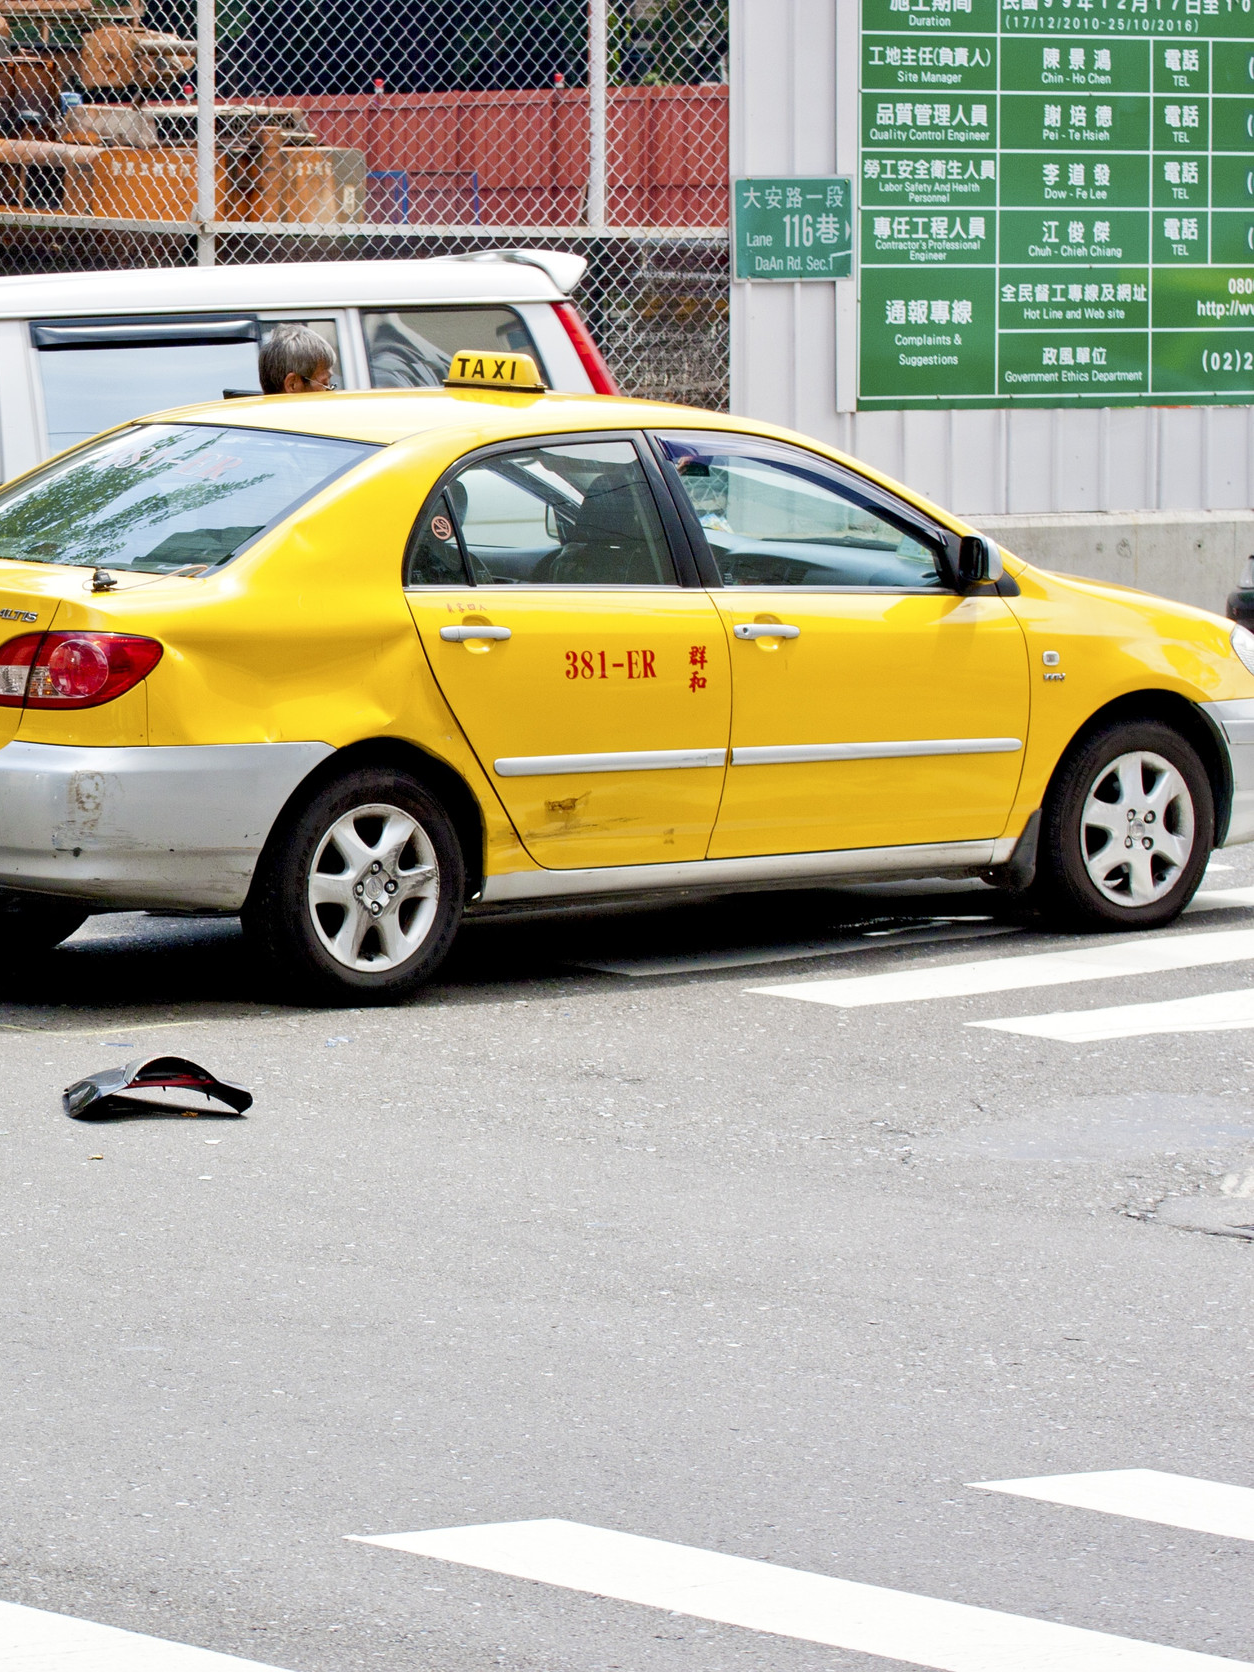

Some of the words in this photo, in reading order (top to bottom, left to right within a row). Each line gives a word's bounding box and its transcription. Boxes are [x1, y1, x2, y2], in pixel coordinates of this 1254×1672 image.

[908, 14, 951, 27] Duration
[868, 46, 992, 67] 工地主任(負責人)
[1164, 49, 1199, 71] 電話
[897, 70, 919, 83] Site
[921, 71, 963, 85] Manager
[1041, 72, 1064, 84] Chin
[1072, 73, 1086, 84] Ho
[1087, 73, 1112, 85] Chen
[1173, 75, 1190, 87] TEL
[876, 103, 988, 127] 品質管理人員
[1044, 104, 1113, 128] 謝培德
[1164, 105, 1199, 128] 電話
[869, 128, 907, 141] Quality
[909, 129, 945, 141] Control
[947, 129, 990, 142] Engineer
[1043, 129, 1059, 141] Pei
[1068, 129, 1081, 141] Te
[1083, 130, 1110, 142] Hsieh
[1172, 131, 1190, 143] TEL
[863, 159, 996, 180] 勞工安全衛生人員
[1042, 163, 1111, 187] 李道發
[1163, 161, 1199, 184] 電話
[879, 182, 903, 192] Labor
[904, 182, 932, 194] Safety
[933, 183, 951, 192] And
[952, 183, 980, 193] Health
[1044, 187, 1067, 199] Dow
[1076, 187, 1088, 199] Fe
[1090, 188, 1108, 199] Lee
[1171, 187, 1189, 199] TEL
[743, 186, 844, 209] 大安路一段
[908, 192, 950, 203] Personnel
[783, 213, 840, 247] 116巷
[873, 217, 986, 239] 專任工程人員
[1042, 221, 1110, 243] 江俊傑
[1163, 218, 1198, 240] 電話
[746, 232, 773, 247] Lane
[875, 240, 927, 250] Contractor's
[928, 240, 980, 250] Professional
[909, 250, 947, 262] Engineer
[1028, 245, 1052, 257] Chuh
[1060, 245, 1088, 257] Chieh
[1089, 245, 1123, 258] Chiang
[1171, 244, 1189, 256] TEL
[755, 256, 784, 270] DaAn
[787, 255, 803, 270] Rd.
[1001, 283, 1147, 303] 全民督工專線及網址
[885, 299, 972, 325] 通報專線
[1023, 308, 1040, 319] Hot
[1043, 308, 1063, 319] Line
[1066, 309, 1081, 319] and
[1084, 308, 1105, 319] Web
[1107, 309, 1125, 319] site
[895, 333, 951, 346] Complaints
[953, 333, 962, 345] &
[899, 353, 959, 367] Suggestions
[1042, 347, 1107, 366] 政風單位
[457, 358, 517, 381] TAXI
[1004, 371, 1058, 383] Government
[1061, 371, 1089, 382] Ethics
[1091, 371, 1143, 383] Department
[565, 649, 657, 680] 381-ER
[688, 645, 708, 693] 群和
